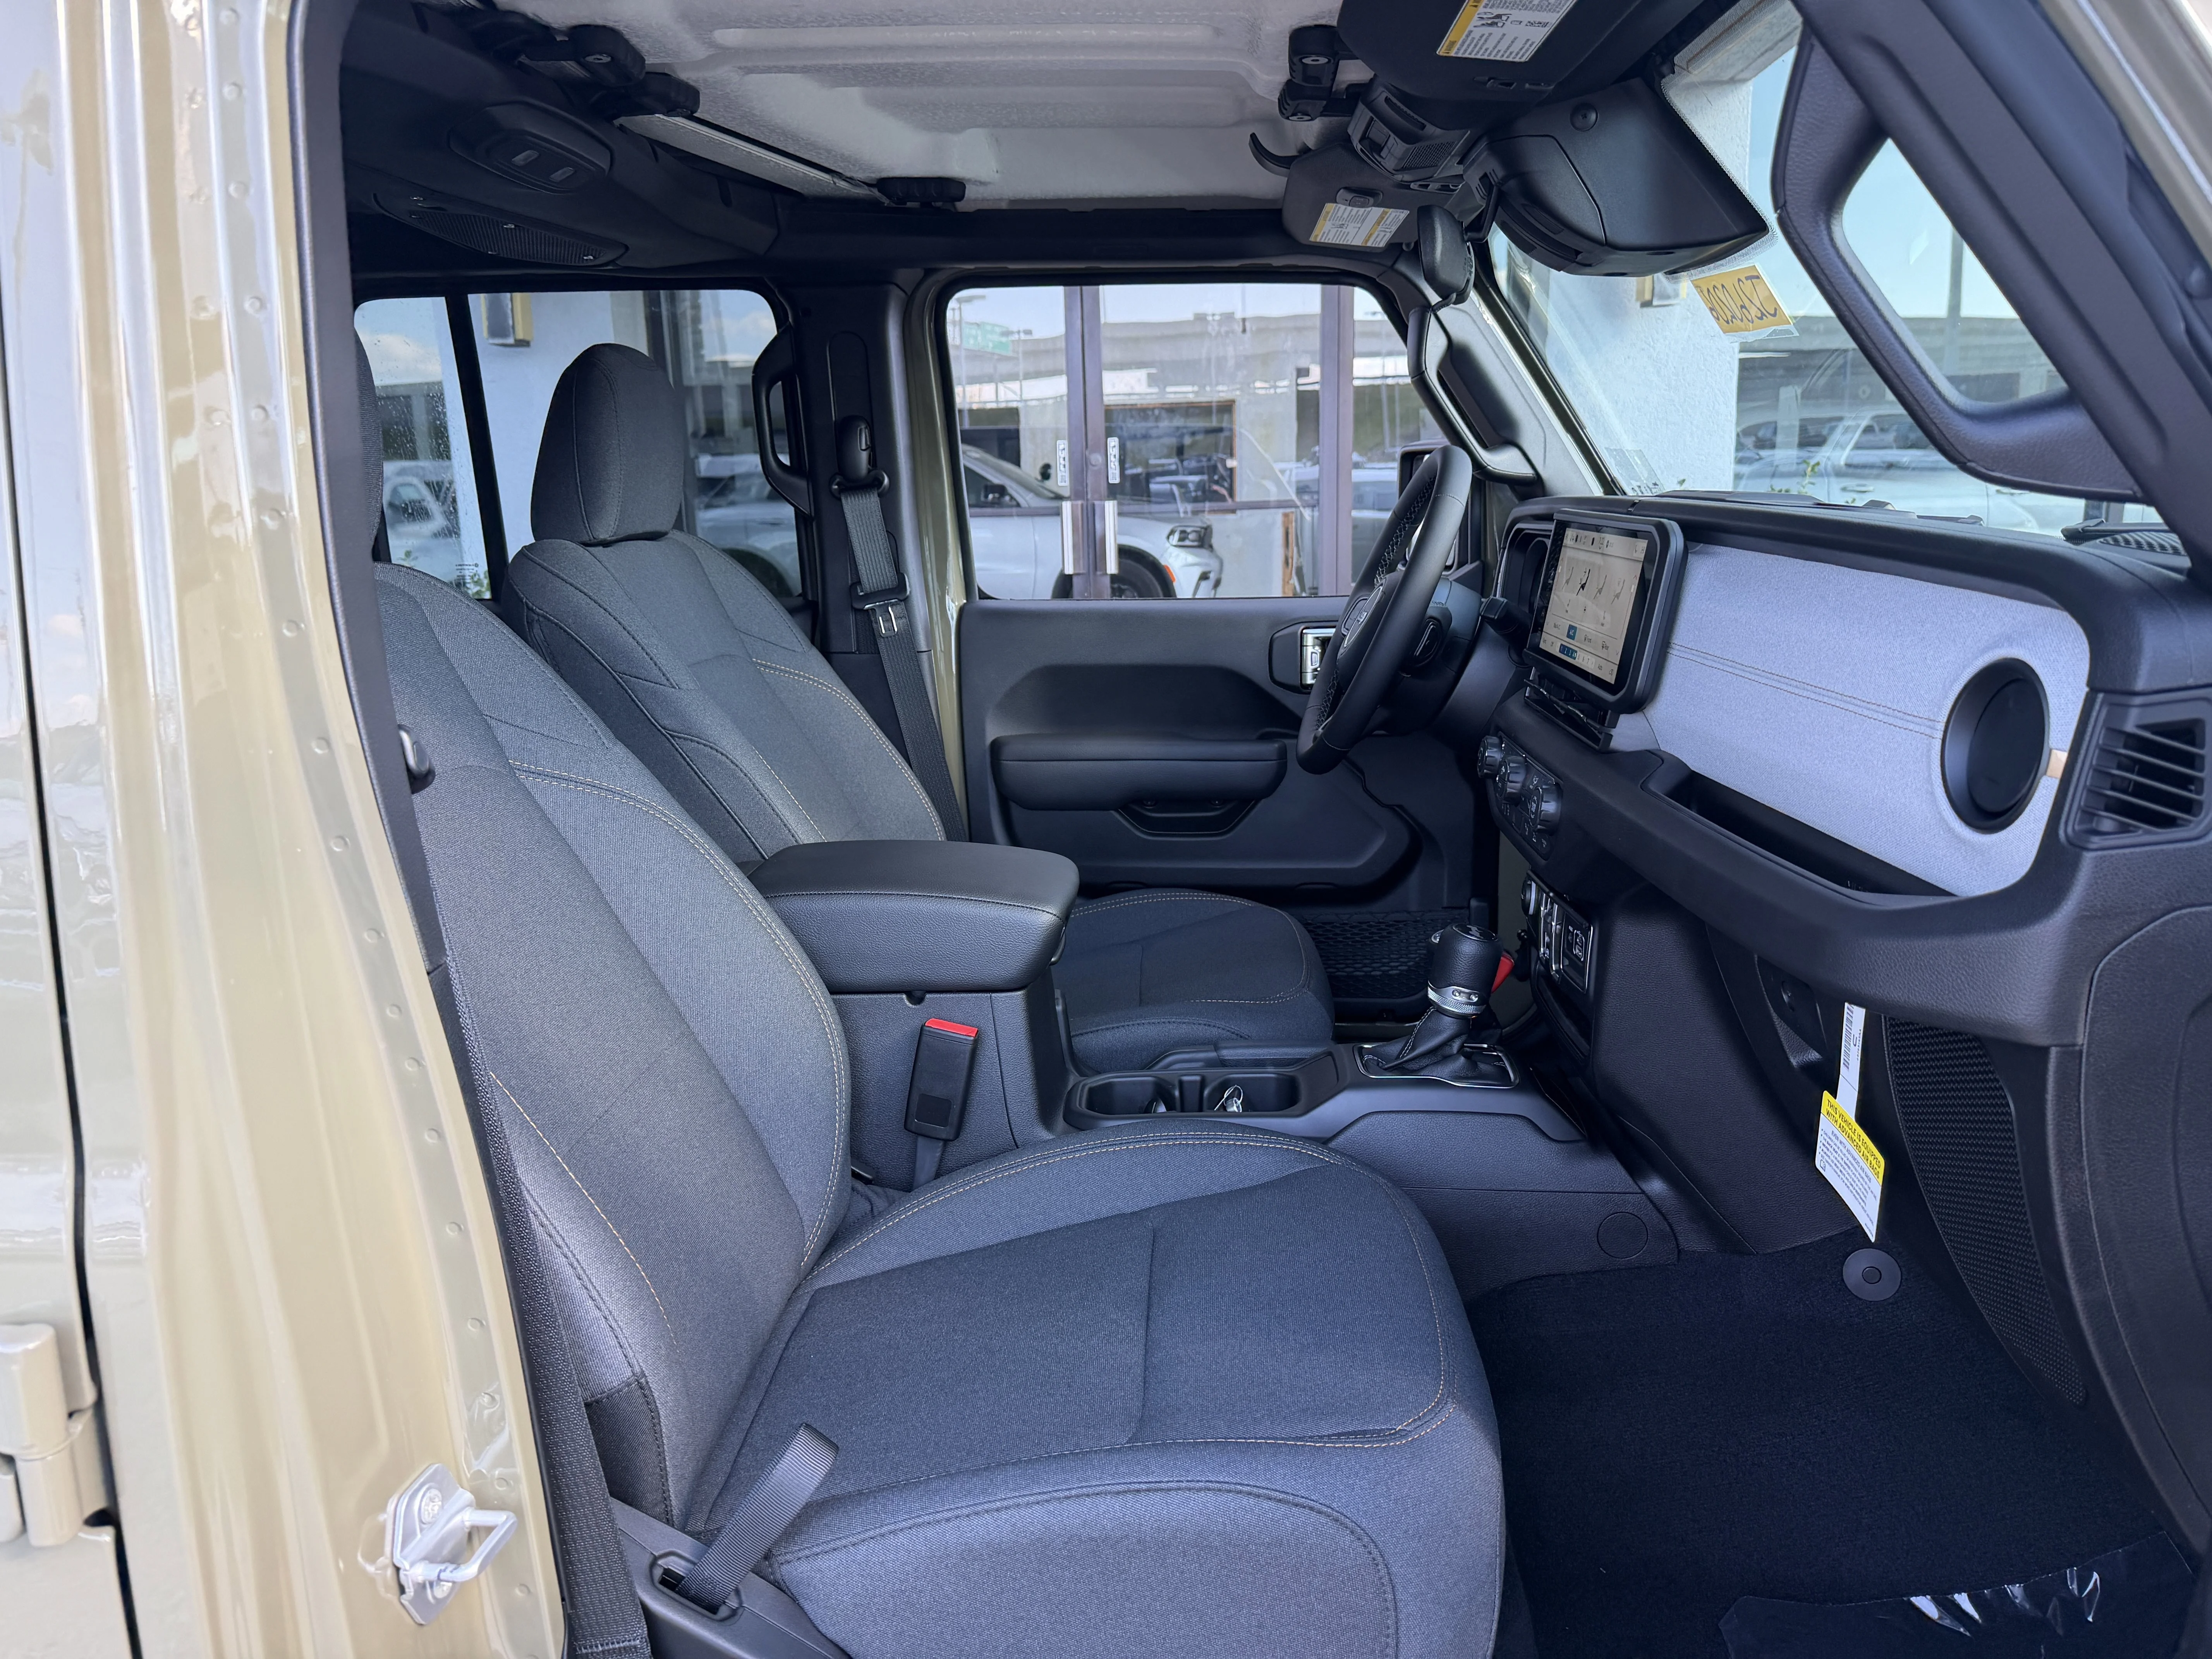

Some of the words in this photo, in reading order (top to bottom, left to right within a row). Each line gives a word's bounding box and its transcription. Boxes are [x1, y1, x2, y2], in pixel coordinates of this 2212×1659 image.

[1826, 1107, 1838, 1127] WITH
[1838, 1121, 1861, 1154] ADVANCED
[1869, 1160, 1879, 1180] BAGS
[1827, 1099, 1837, 1116] THIS
[1838, 1110, 1856, 1137] VEHICLE
[1856, 1132, 1861, 1143] IS
[1862, 1138, 1881, 1170] EQUIPPED
